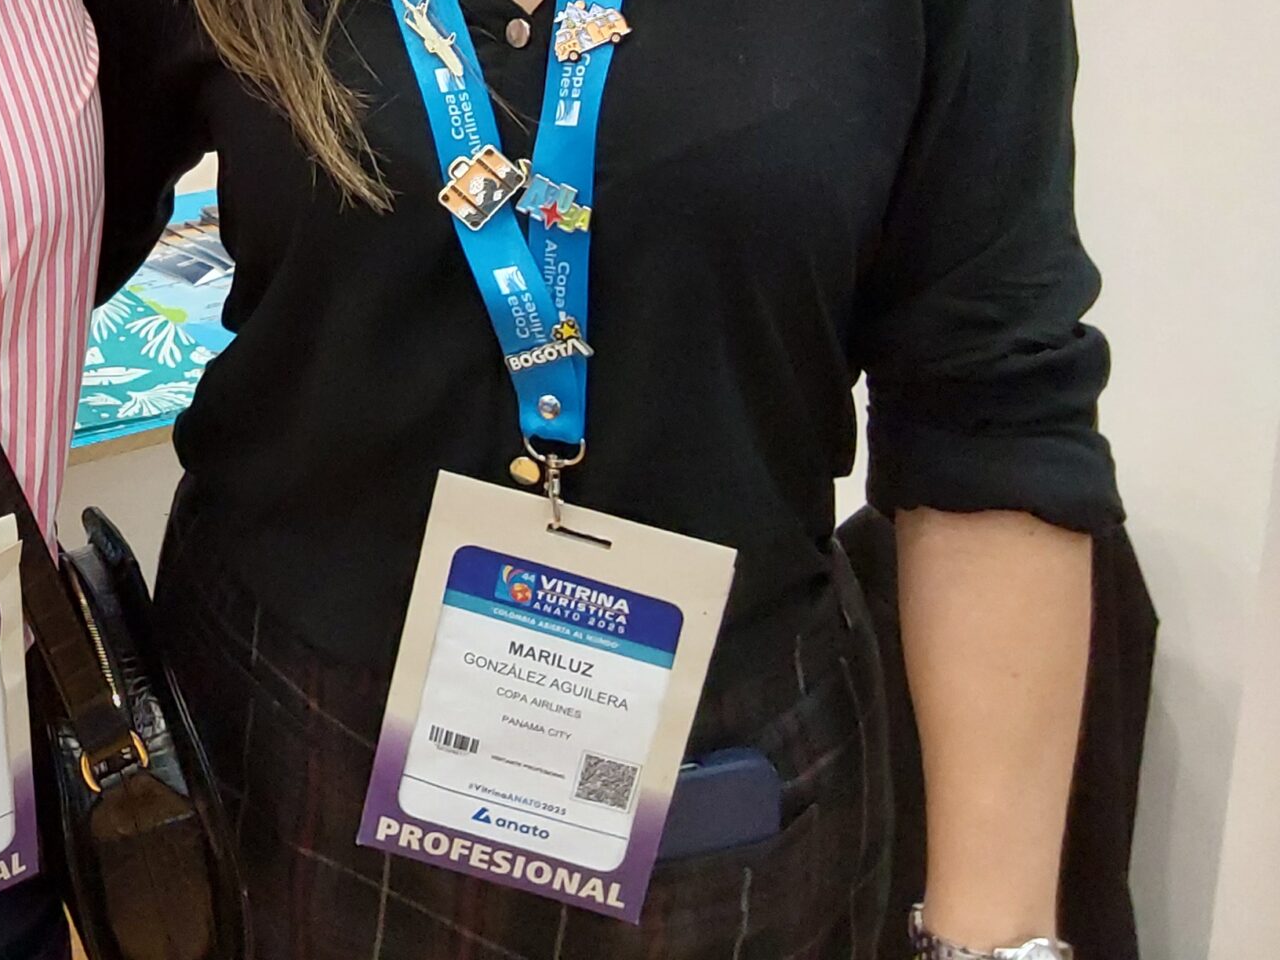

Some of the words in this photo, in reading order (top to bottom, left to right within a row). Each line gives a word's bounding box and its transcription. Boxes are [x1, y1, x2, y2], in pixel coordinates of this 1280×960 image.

[445, 94, 464, 140] Copa
[543, 239, 558, 289] Airlin
[554, 261, 570, 309] Copa
[507, 295, 530, 339] Copa
[520, 292, 548, 343] irlines
[532, 601, 581, 621] ANATO
[540, 574, 630, 614] VITRINA
[463, 651, 547, 686] GONZÁLEZ
[549, 678, 629, 711] AGUILERA
[508, 641, 595, 678] MARILUZ
[496, 686, 528, 704] COPA
[530, 697, 583, 719] AIRLINES
[501, 714, 545, 734] PANAMA
[548, 727, 572, 741] CITY
[495, 817, 550, 840] anato
[375, 815, 626, 909] PROFESIONAL
